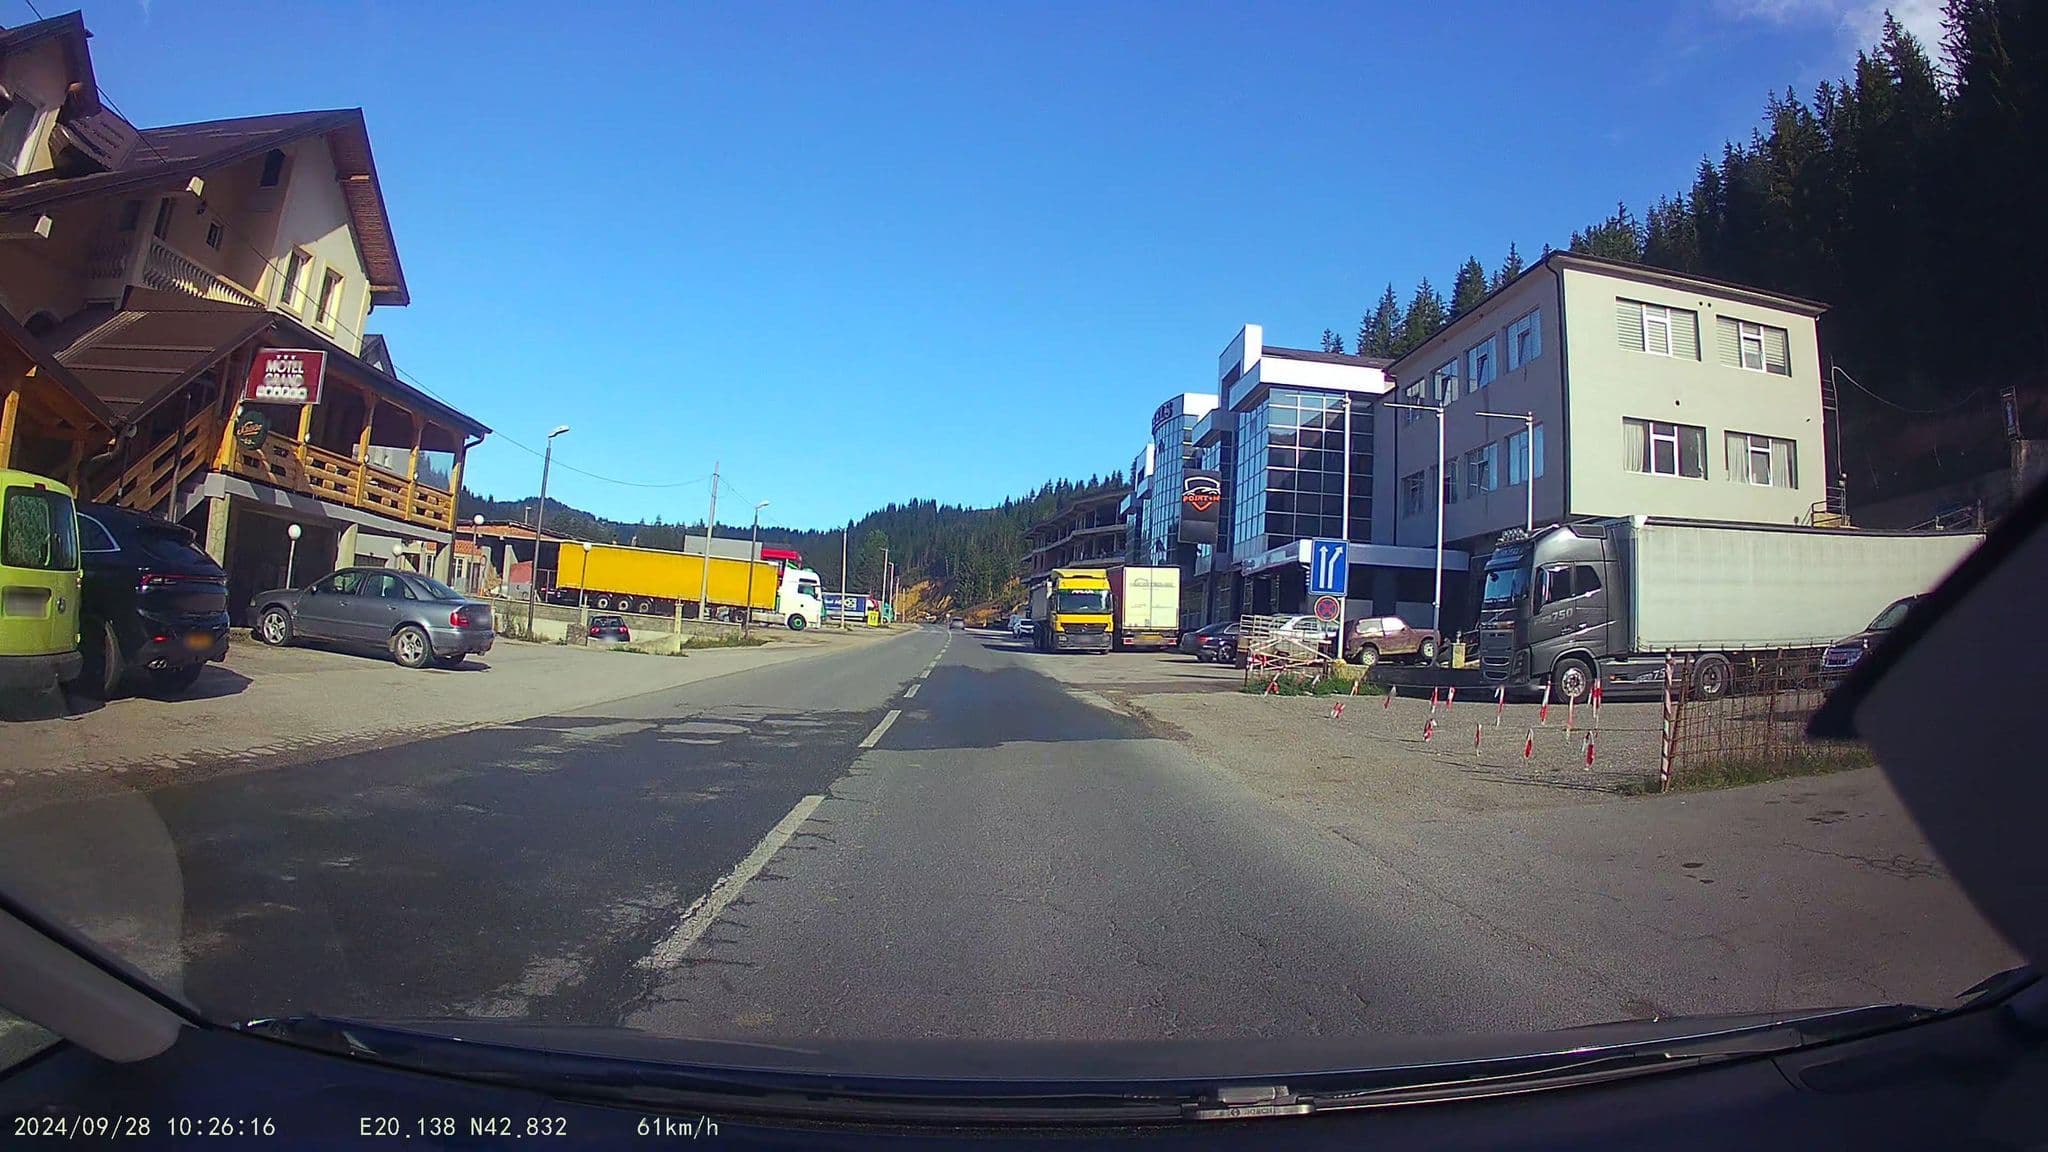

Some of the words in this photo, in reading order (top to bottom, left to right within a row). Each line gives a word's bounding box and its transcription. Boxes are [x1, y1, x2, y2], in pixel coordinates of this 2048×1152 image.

[265, 360, 304, 373] MOTEL
[263, 373, 304, 387] GRAND
[1552, 608, 1573, 621] 750
[1653, 668, 1666, 679] 75
